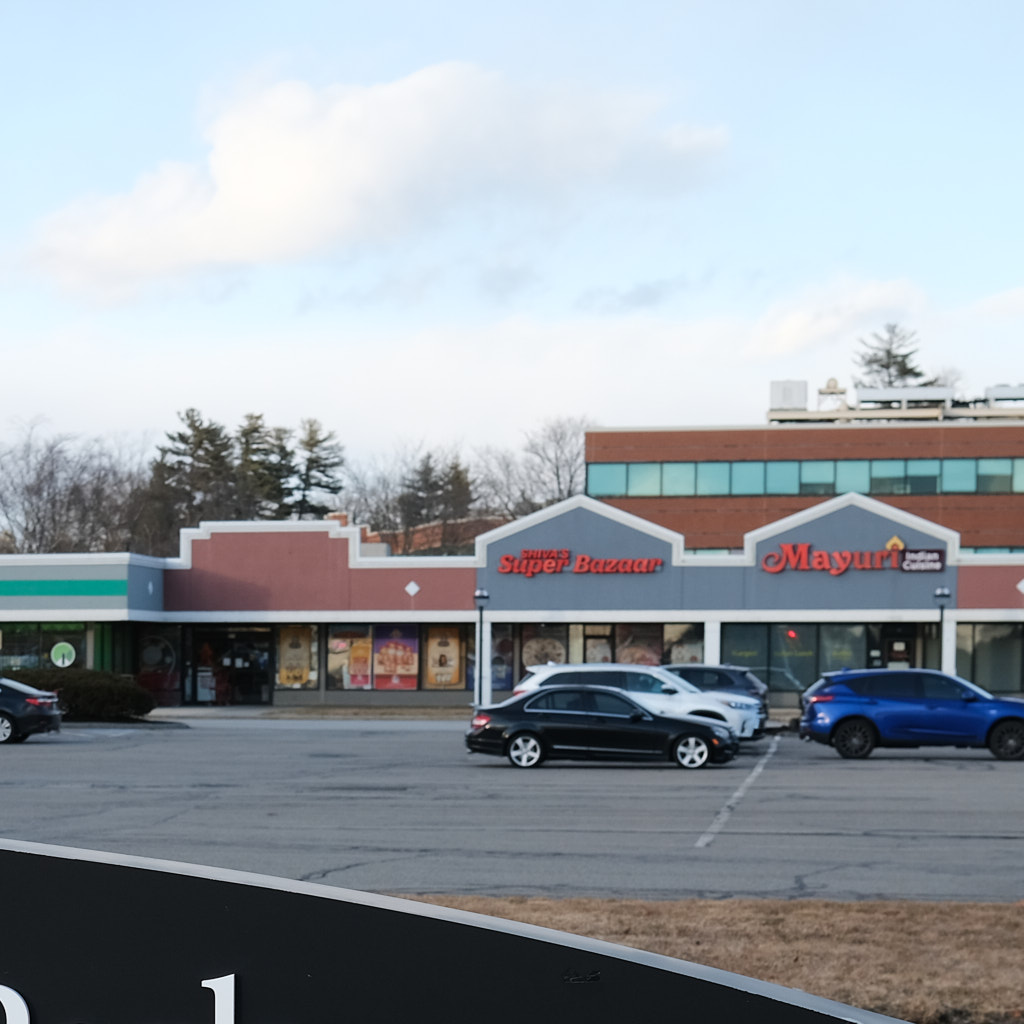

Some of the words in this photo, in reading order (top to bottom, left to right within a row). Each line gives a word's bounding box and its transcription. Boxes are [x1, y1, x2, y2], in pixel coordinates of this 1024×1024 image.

[521, 549, 569, 560] SHIVA'S
[761, 542, 899, 576] Mayuri
[905, 551, 940, 560] Indian
[498, 555, 569, 577] Super
[573, 555, 663, 574] Bazaar
[902, 560, 943, 571] Cuisine
